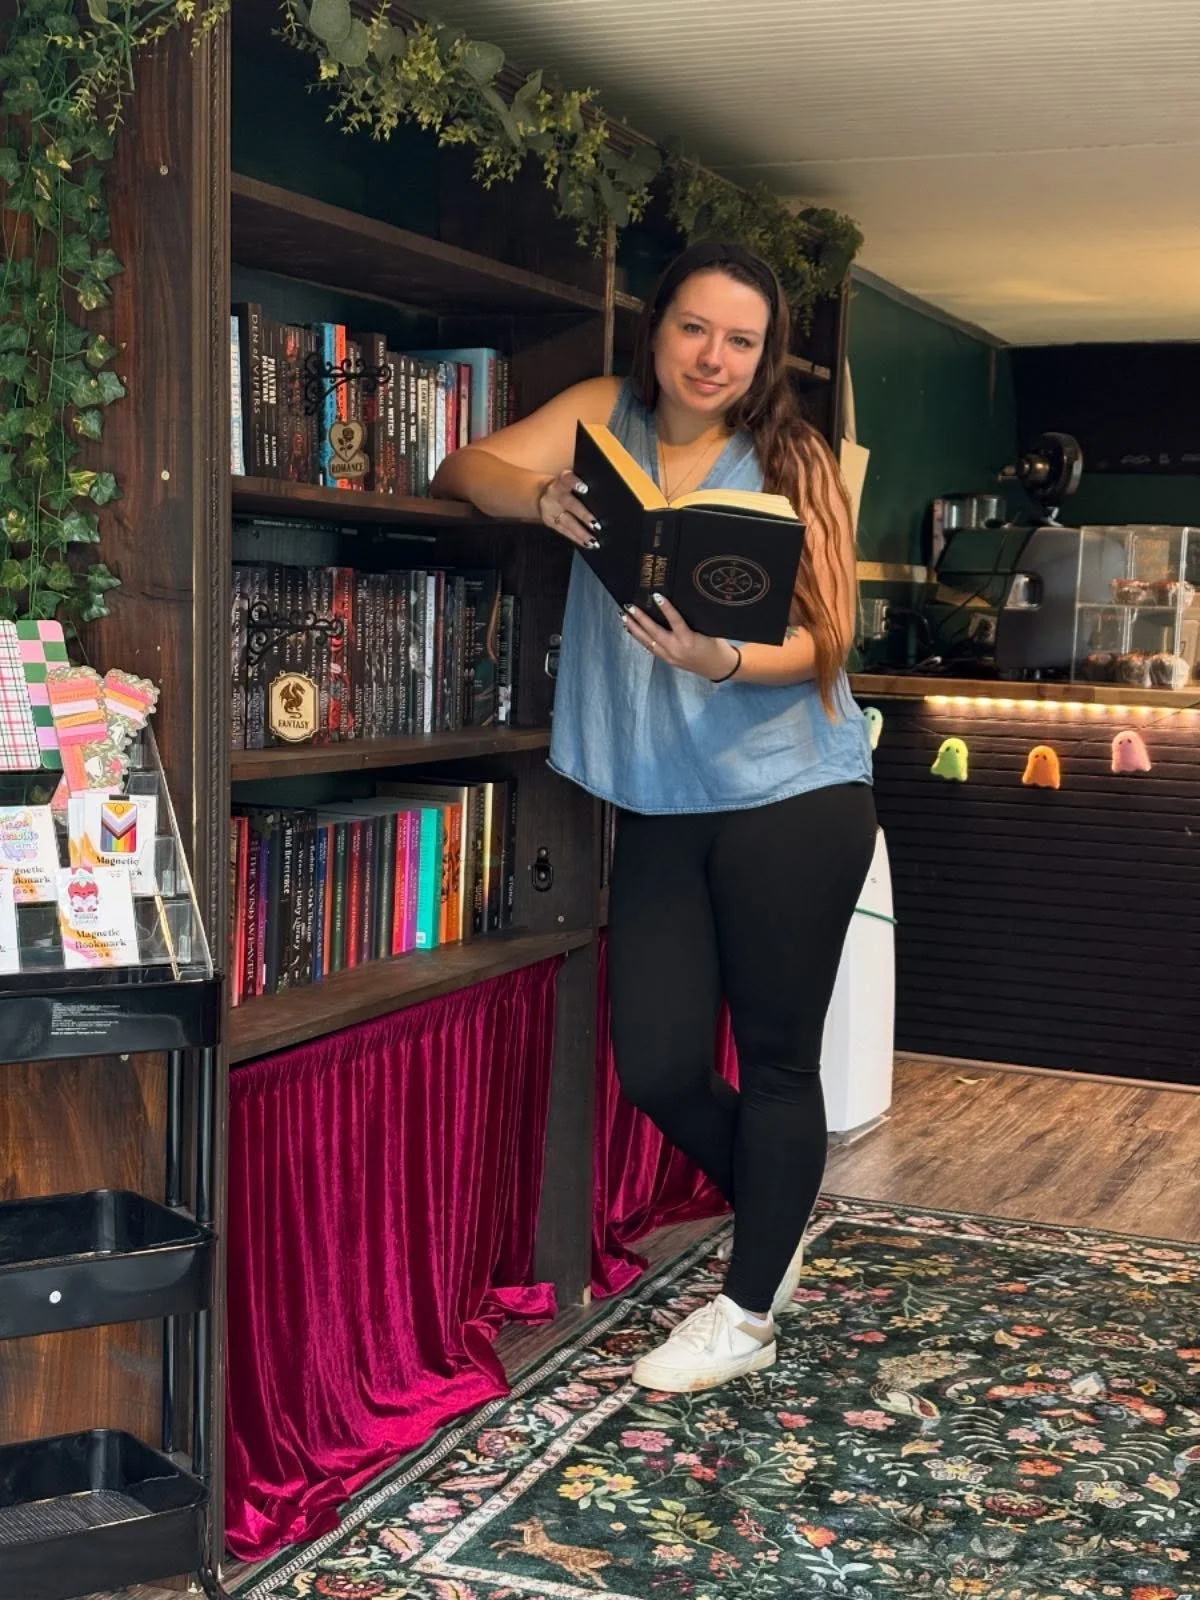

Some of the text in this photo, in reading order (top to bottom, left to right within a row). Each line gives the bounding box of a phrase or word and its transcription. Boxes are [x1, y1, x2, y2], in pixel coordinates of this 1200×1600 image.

[251, 314, 259, 343] DEN
[253, 366, 261, 415] VIPERS
[268, 358, 277, 405] PHANTOM
[420, 383, 428, 404] LEAVE
[387, 407, 395, 437] WITCH
[420, 405, 428, 417] ME
[331, 462, 364, 473] ROMANCE
[278, 721, 310, 732] FANTASY
[249, 856, 257, 880] THE
[283, 827, 293, 894] Wild Reverence
[351, 862, 359, 892] QUEEN
[248, 883, 256, 920] WIND
[293, 890, 304, 916] Holly
[306, 844, 316, 943] Robin Oak Throne
[75, 928, 121, 940] Magnetic
[75, 938, 127, 949] Bookmark
[292, 917, 304, 950] Library
[247, 922, 255, 981] WEAVER
